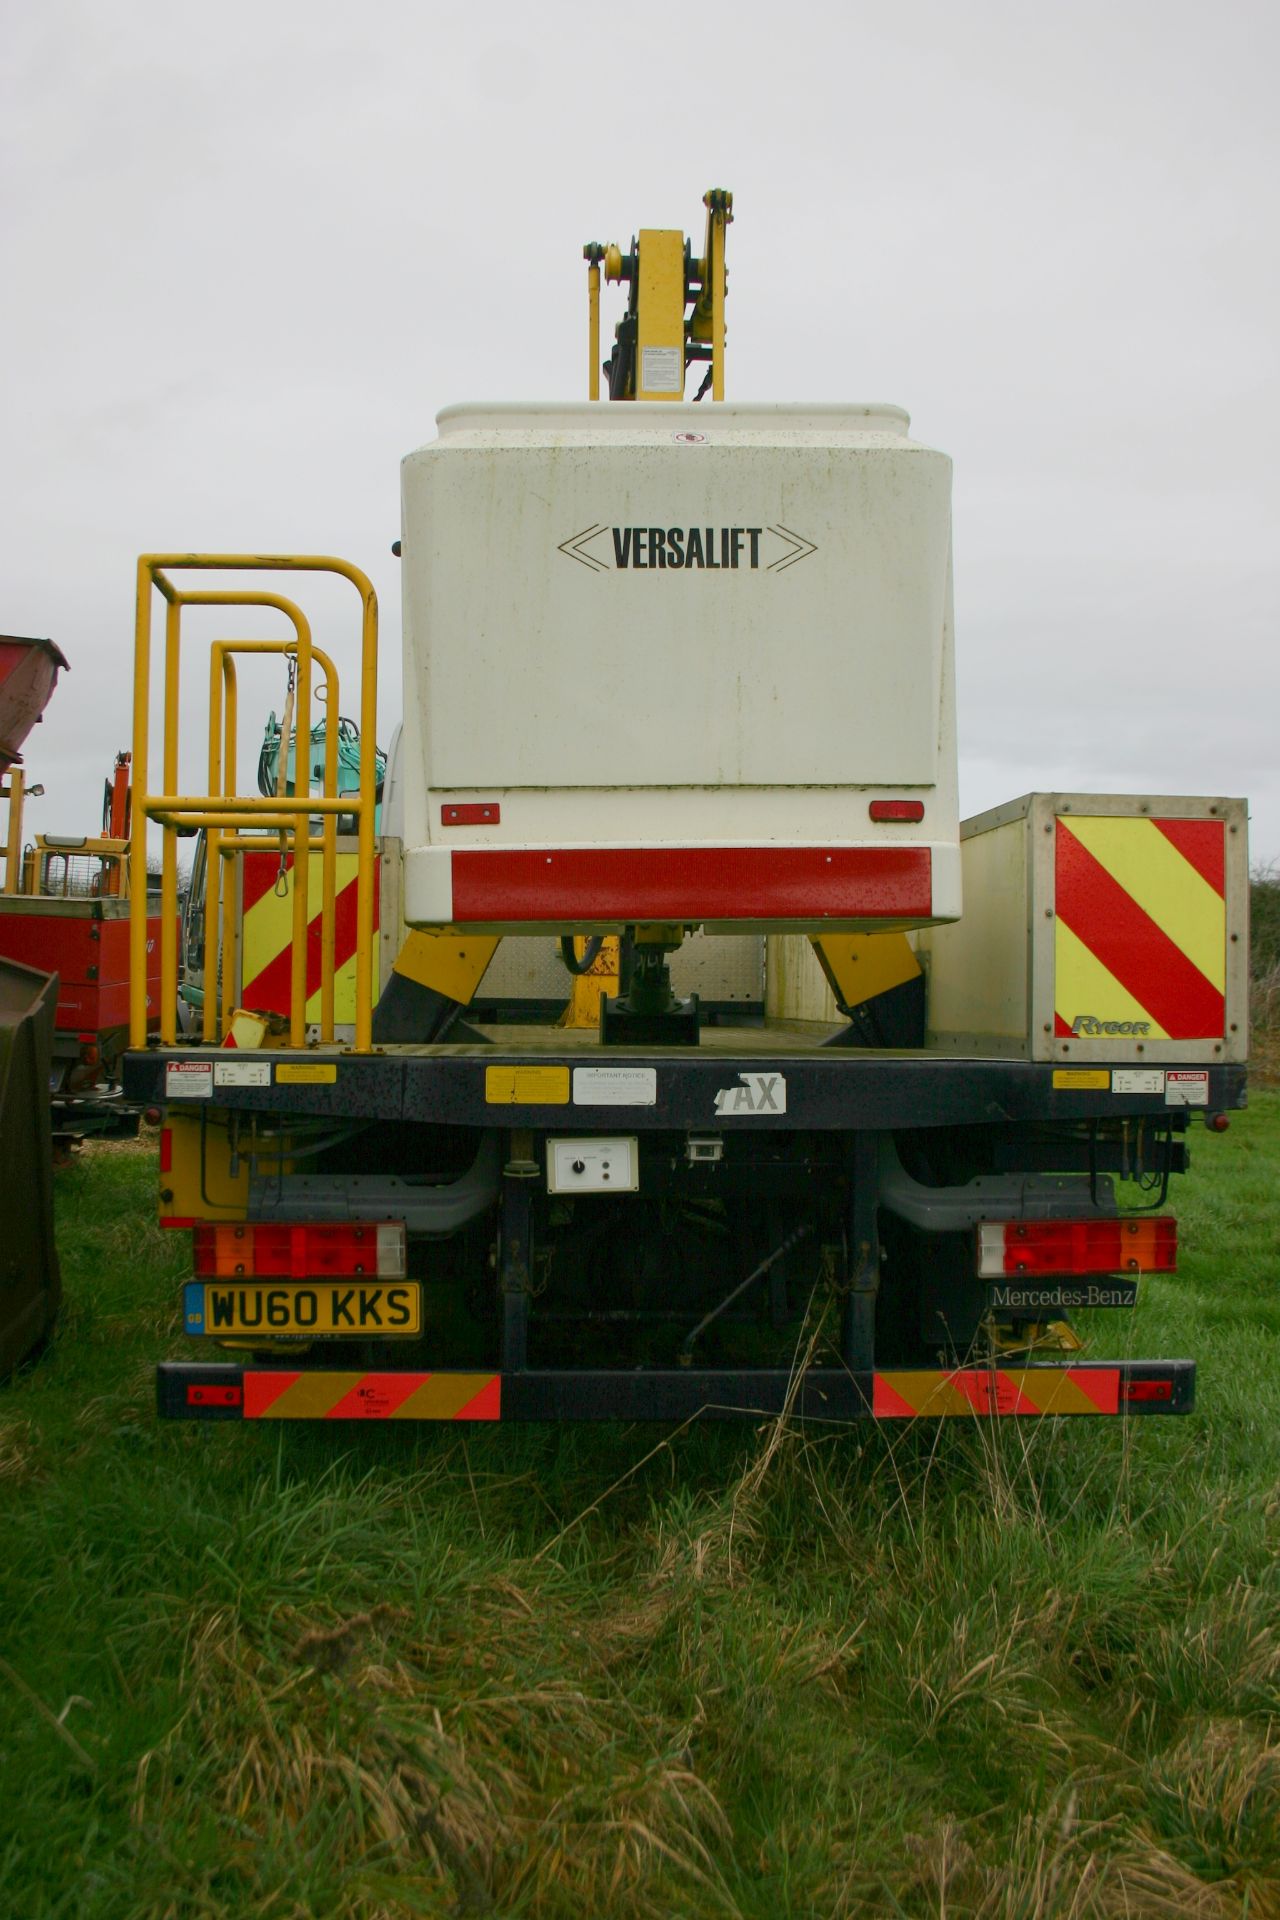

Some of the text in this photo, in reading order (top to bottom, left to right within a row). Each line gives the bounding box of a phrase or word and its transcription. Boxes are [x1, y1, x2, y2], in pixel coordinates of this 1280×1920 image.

[612, 527, 763, 569] VERSALIFT
[179, 1064, 210, 1072] DANGER
[586, 1071, 646, 1079] IMPORTANT NOTICE
[1177, 1073, 1205, 1081] DANGER
[991, 1285, 1134, 1306] Mercedes-Benz
[211, 1288, 411, 1327] WU60 KKS
